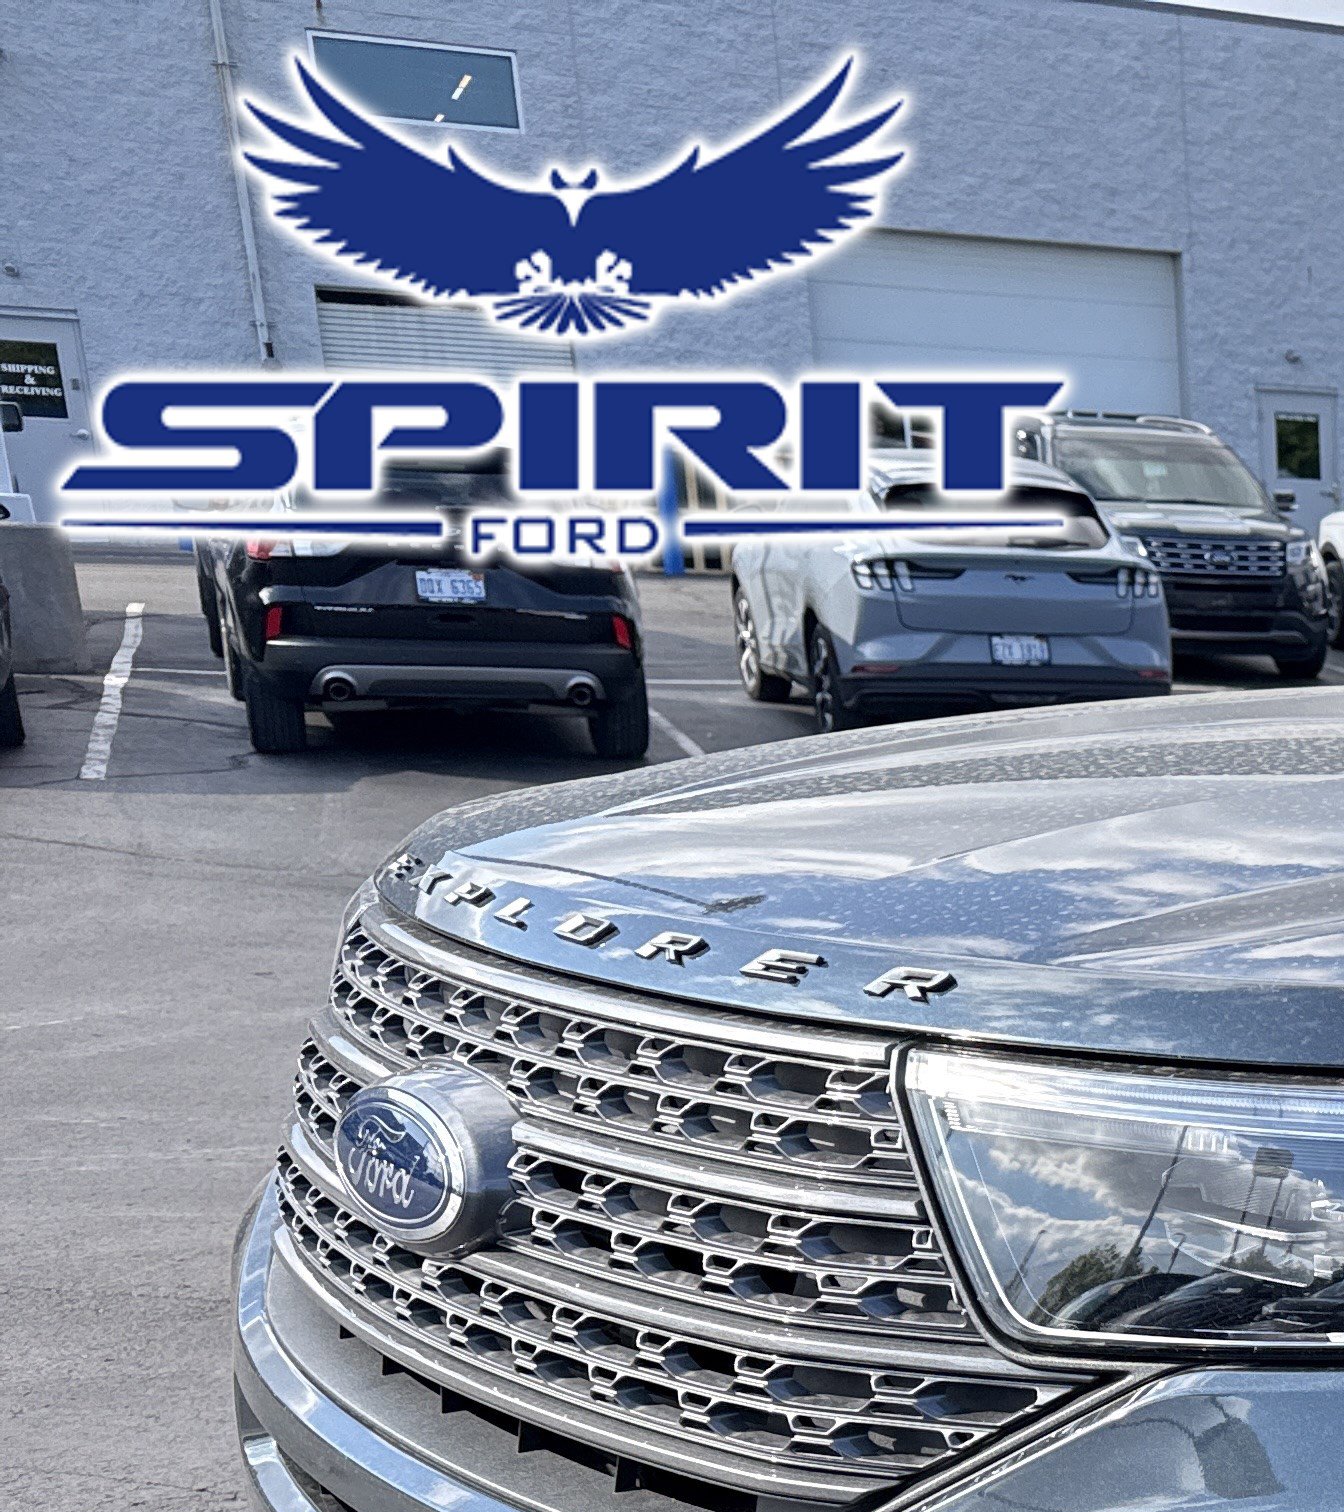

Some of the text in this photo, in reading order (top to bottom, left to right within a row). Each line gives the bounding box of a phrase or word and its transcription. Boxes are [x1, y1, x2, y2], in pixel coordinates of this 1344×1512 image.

[0, 363, 55, 375] SHIPPING
[24, 374, 36, 385] &
[0, 385, 62, 397] RECEIVING
[390, 852, 960, 1005] EXPLORER
[348, 1114, 421, 1209] Ford
